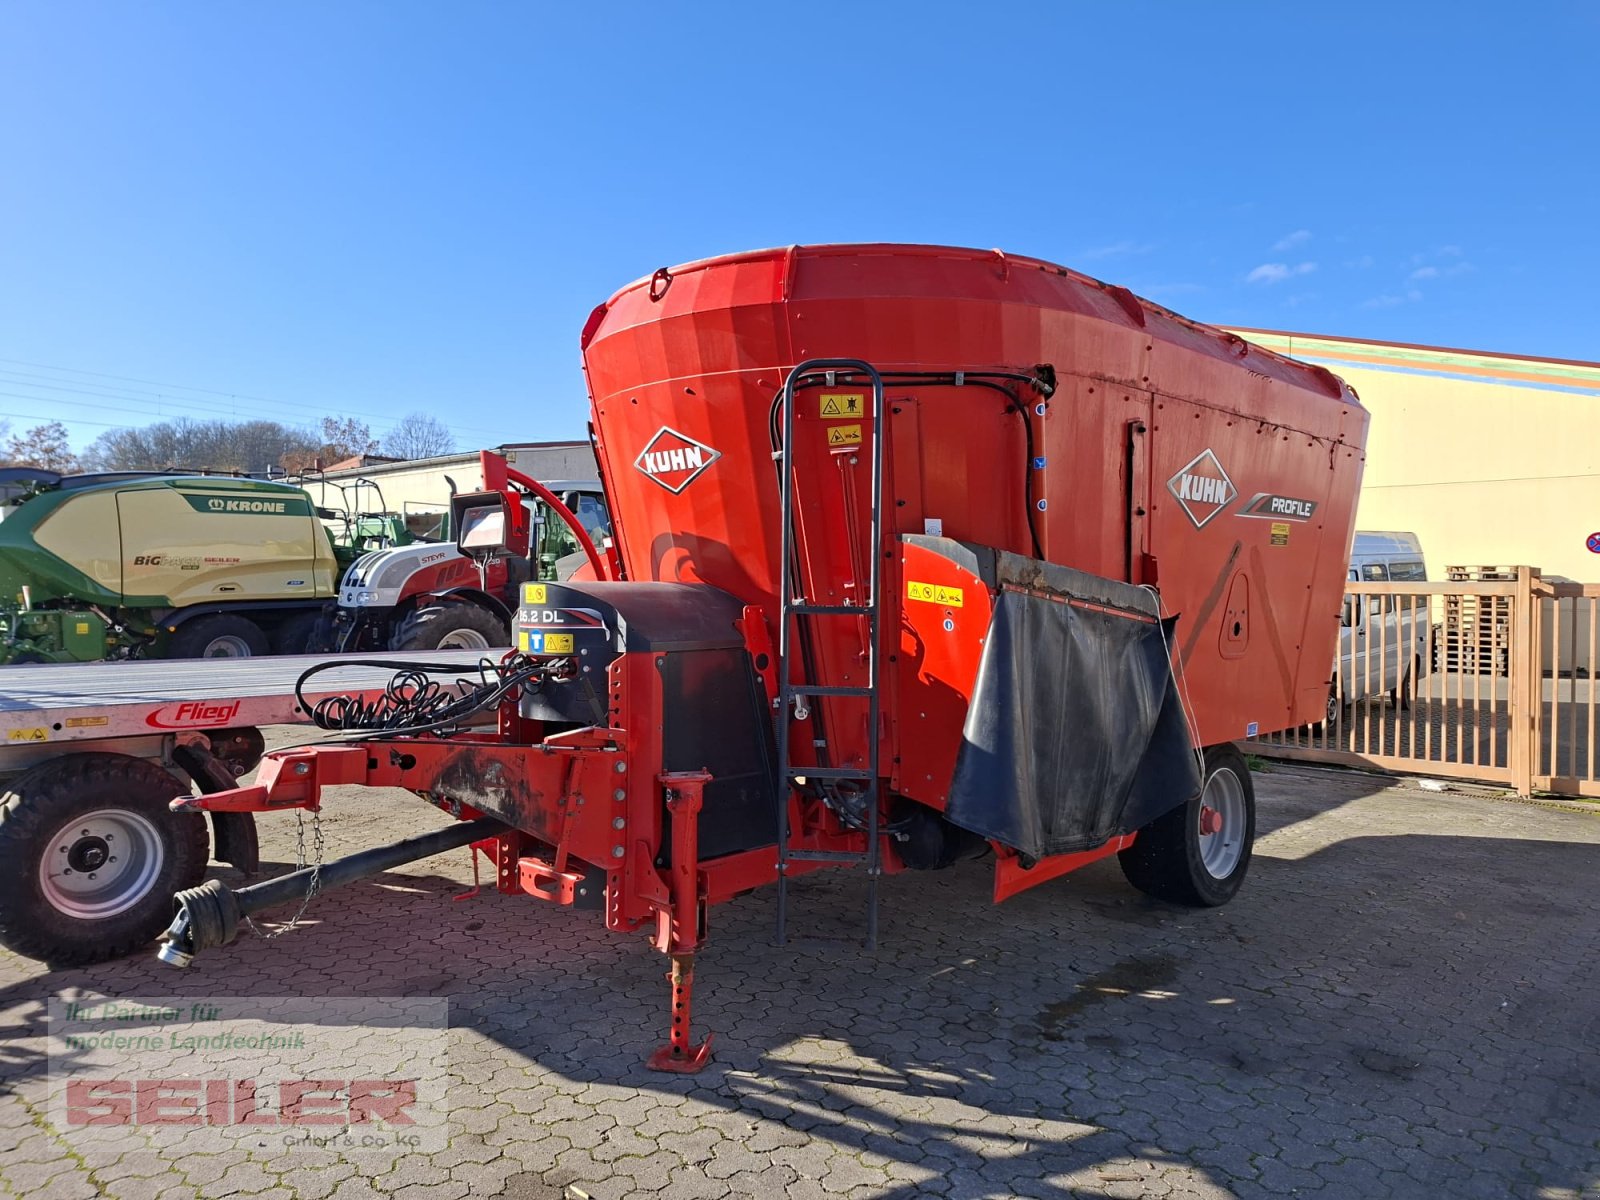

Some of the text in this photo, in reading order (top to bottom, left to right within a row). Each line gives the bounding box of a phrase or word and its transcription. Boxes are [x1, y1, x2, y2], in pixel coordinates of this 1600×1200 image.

[644, 446, 703, 474] KUHN
[1179, 473, 1227, 504] KUHN
[226, 500, 285, 513] KRONE
[1271, 497, 1312, 517] PROFILE
[422, 552, 446, 564] STEYR
[543, 610, 564, 623] DL
[175, 700, 241, 722] Fliegl
